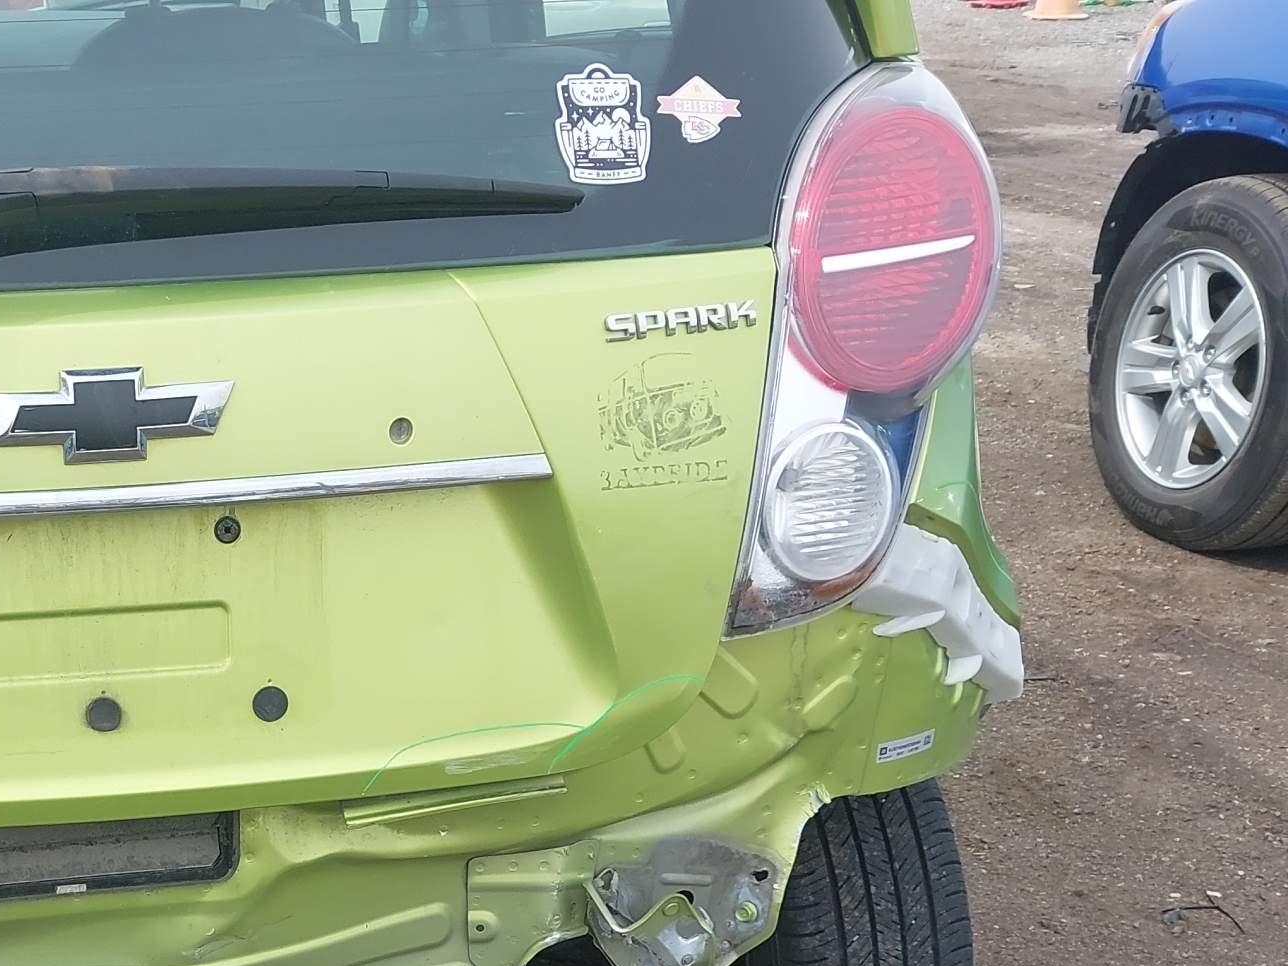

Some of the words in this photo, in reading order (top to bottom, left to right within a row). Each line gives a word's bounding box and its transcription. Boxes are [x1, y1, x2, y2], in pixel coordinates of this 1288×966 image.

[580, 90, 620, 102] CAMPING
[674, 100, 724, 113] CHIEFS
[605, 300, 757, 342] SPARK
